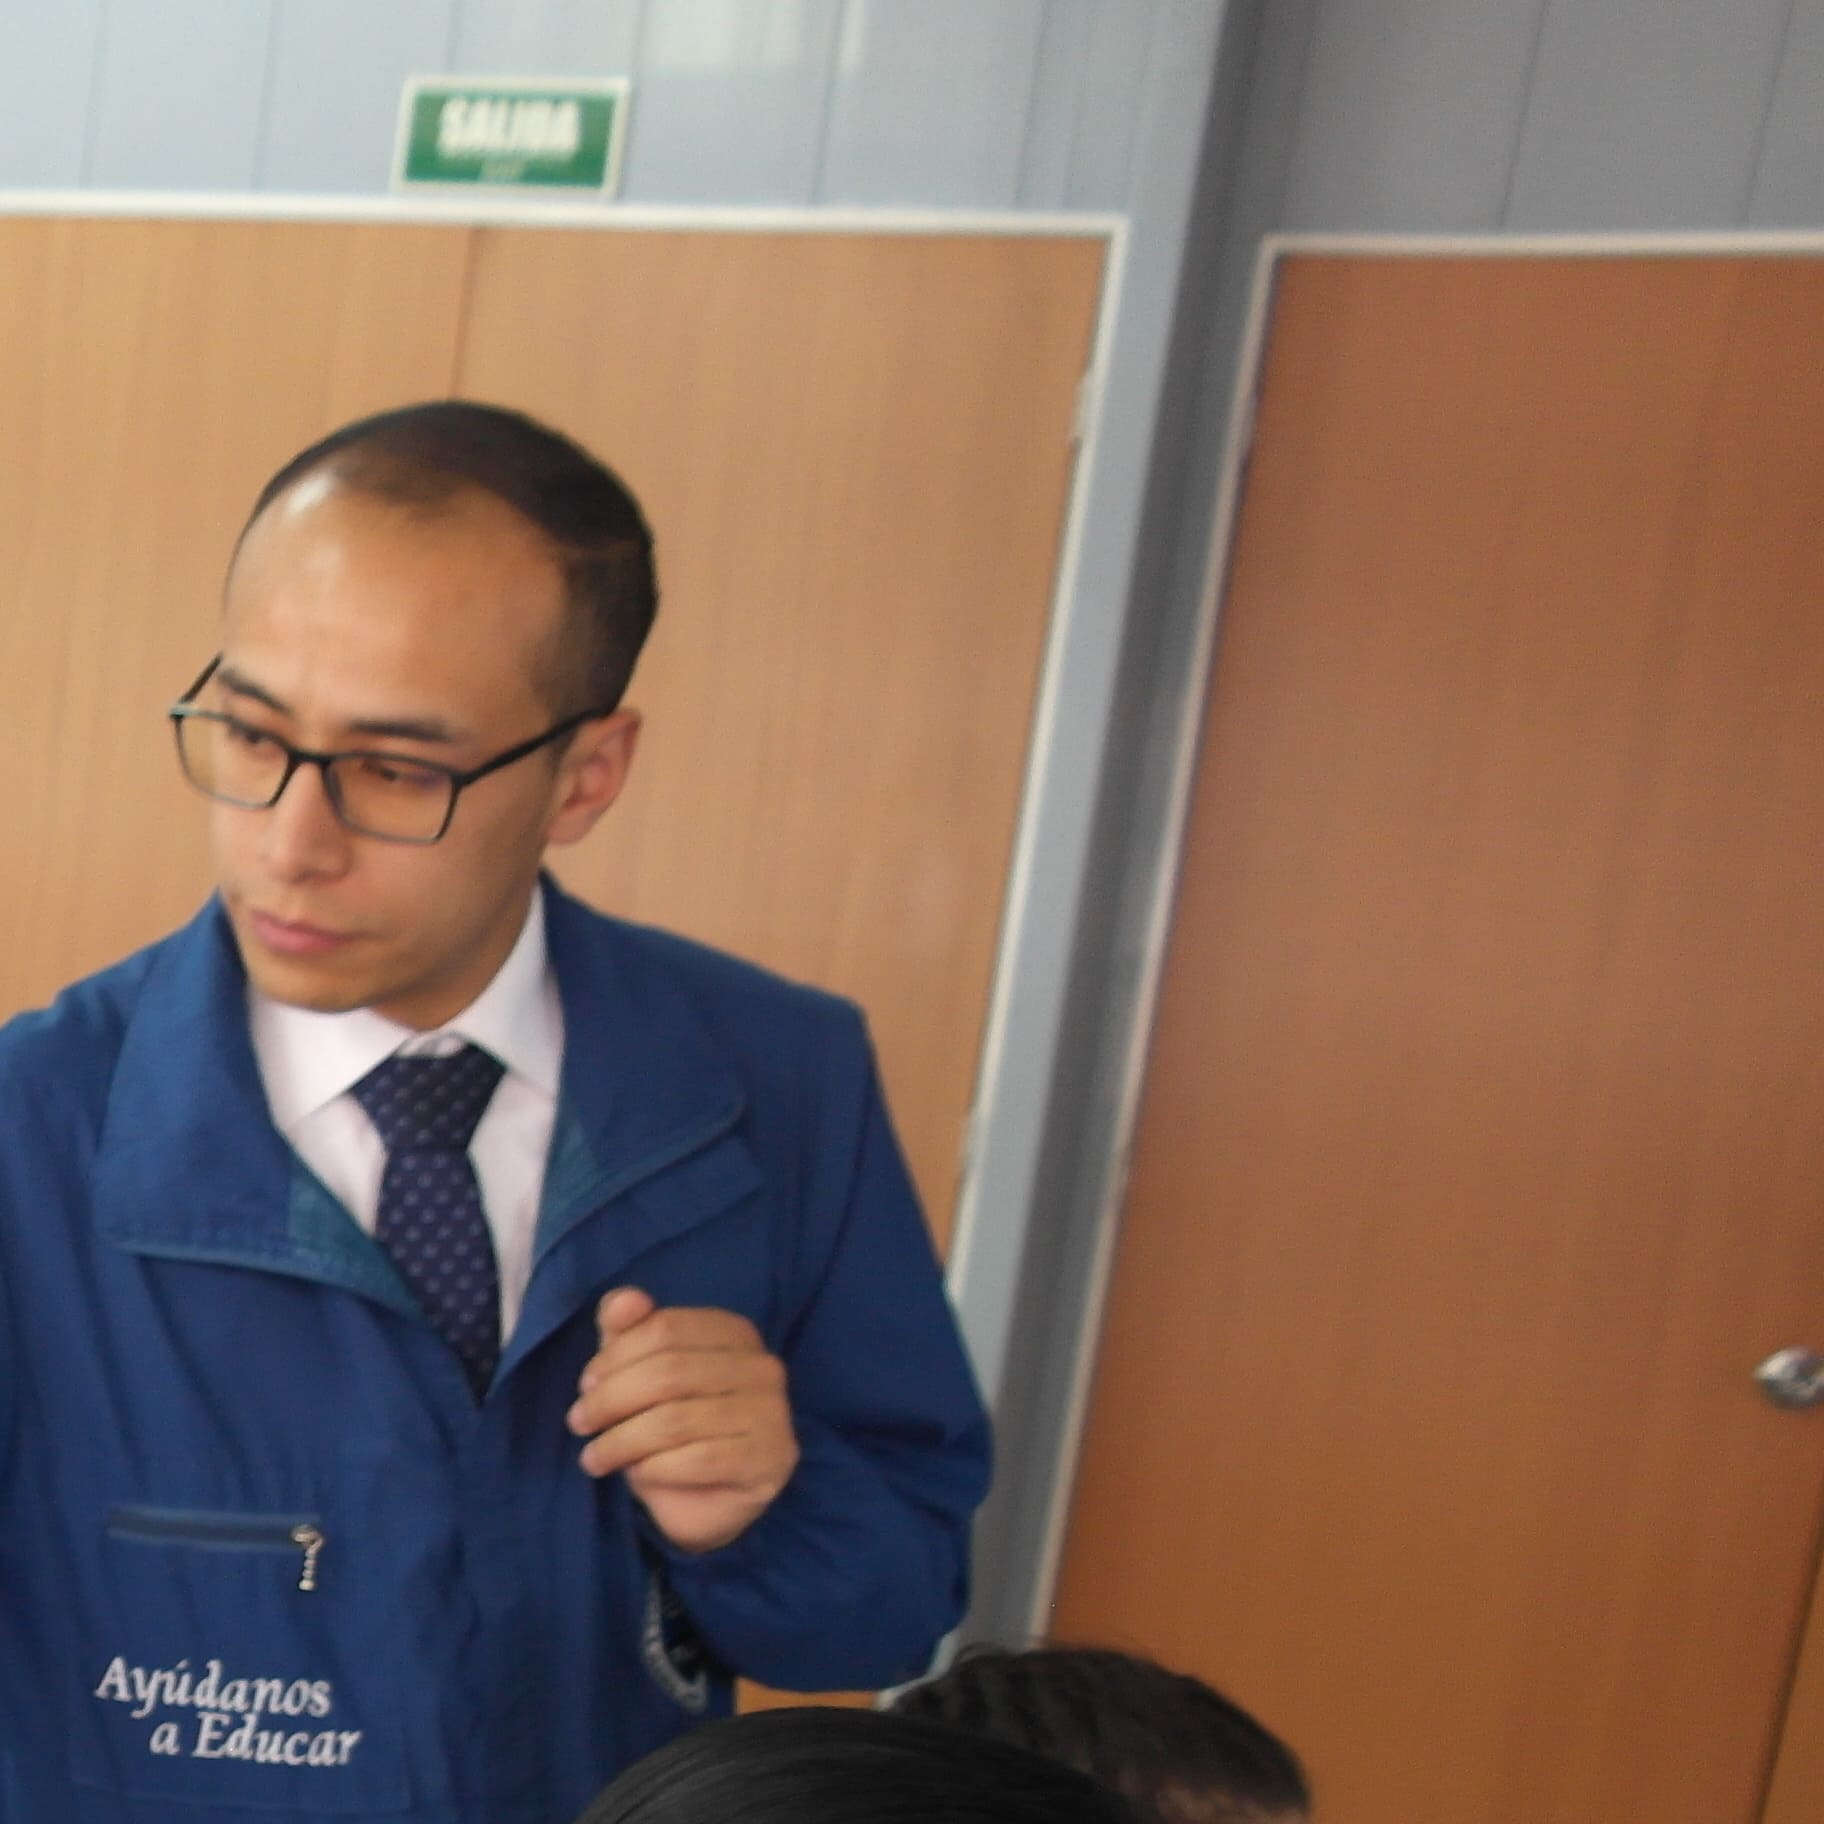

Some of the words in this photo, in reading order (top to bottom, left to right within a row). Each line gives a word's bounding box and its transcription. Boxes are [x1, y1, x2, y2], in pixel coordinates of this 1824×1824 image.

[93, 1654, 333, 1720] Ayúdanos
[148, 1721, 180, 1756] a
[190, 1710, 362, 1768] Educar
